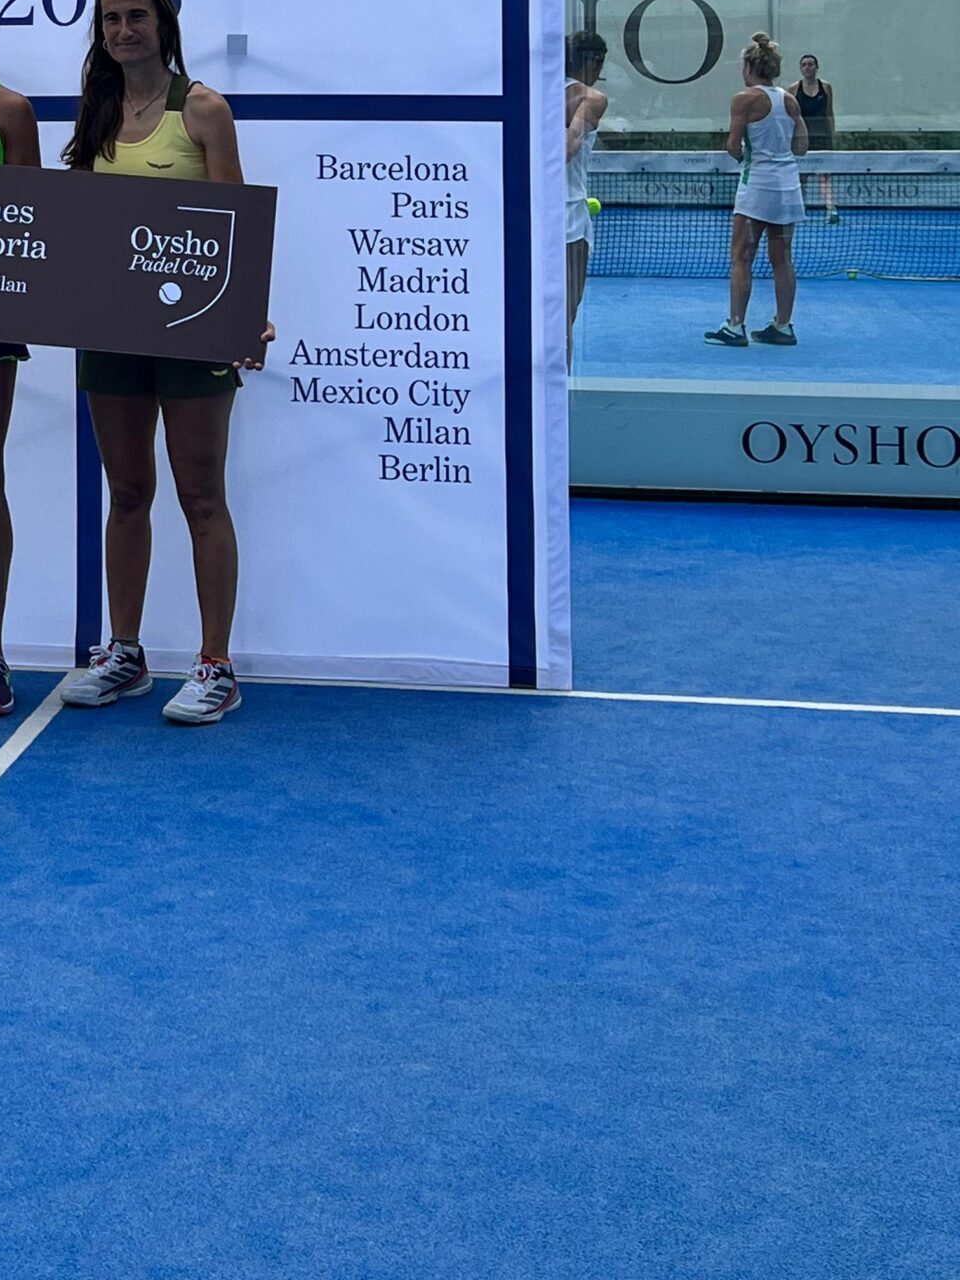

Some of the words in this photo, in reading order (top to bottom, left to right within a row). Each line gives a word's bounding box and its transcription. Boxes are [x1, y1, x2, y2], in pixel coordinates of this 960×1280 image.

[316, 154, 469, 182] Barcelona
[391, 192, 469, 220] Paris
[130, 225, 220, 259] Oysho
[347, 228, 470, 257] Warsaw
[128, 254, 181, 274] Padel
[181, 258, 218, 281] Cup
[357, 266, 470, 295] Madrid
[354, 303, 470, 332] London
[288, 338, 470, 370] Amsterdam
[290, 376, 399, 406] Mexico
[408, 379, 472, 415] City
[383, 416, 472, 446] Milan
[741, 420, 960, 468] OYSHO
[378, 454, 472, 484] Berlin
